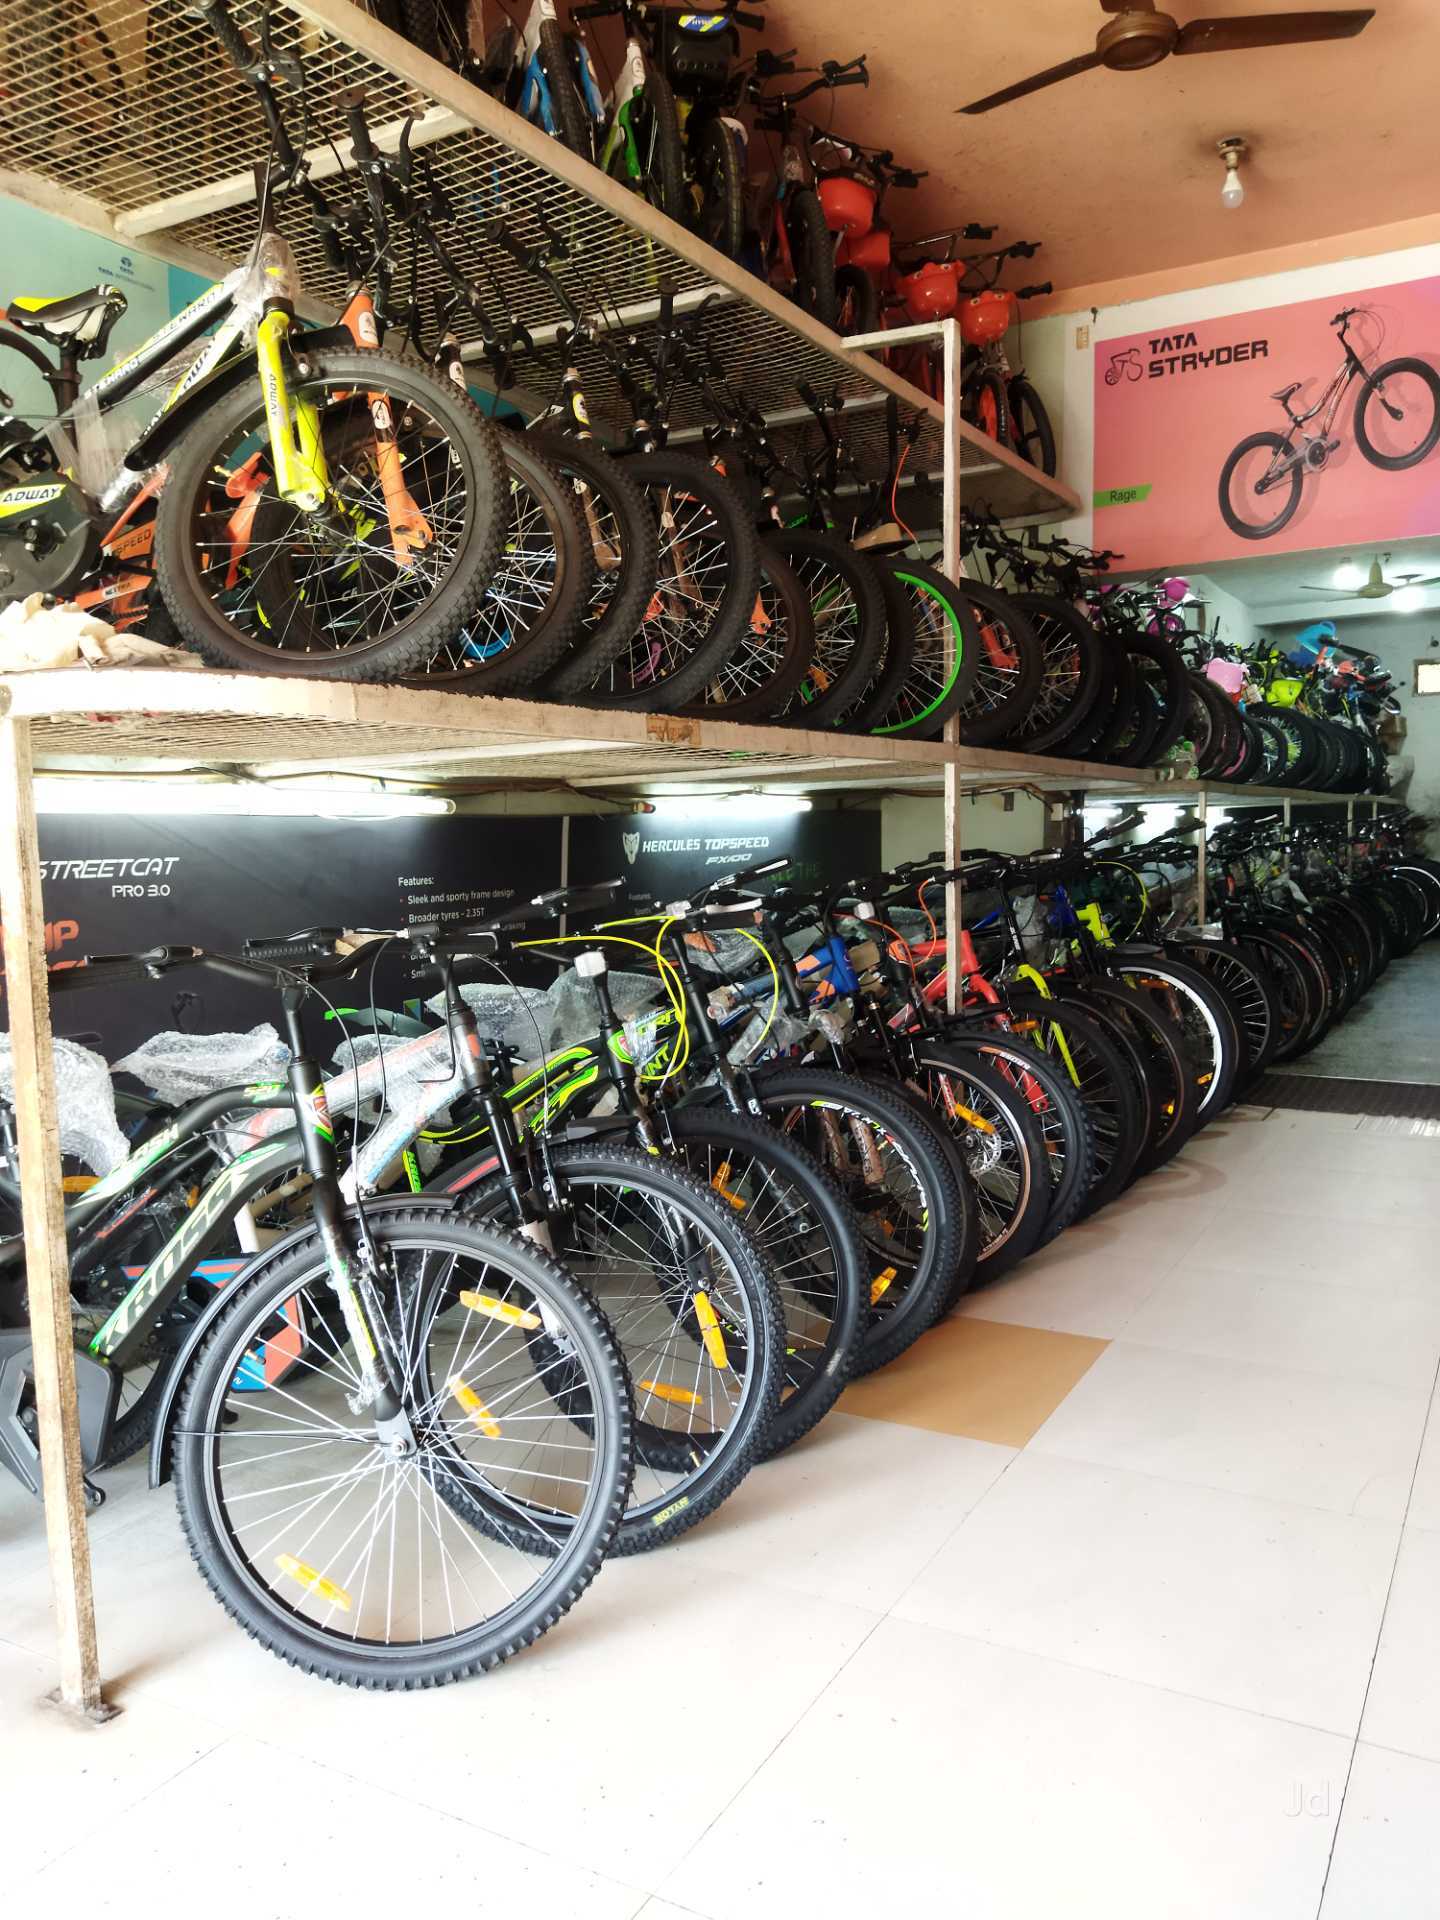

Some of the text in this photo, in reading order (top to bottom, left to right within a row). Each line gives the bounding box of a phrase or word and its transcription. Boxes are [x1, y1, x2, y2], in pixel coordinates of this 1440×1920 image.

[1148, 332, 1198, 354] TATA
[1148, 339, 1269, 379] STRYDER
[1110, 488, 1137, 503] Rage
[642, 836, 770, 853] HERCULES TOPSPEED
[398, 876, 435, 888] Features:
[112, 884, 171, 898] PRO 3.0
[408, 895, 429, 905] Sleek
[431, 893, 445, 903] and
[446, 891, 470, 903] sporty
[471, 889, 490, 900] frame
[409, 911, 439, 924] Broader
[441, 910, 460, 922] tyres
